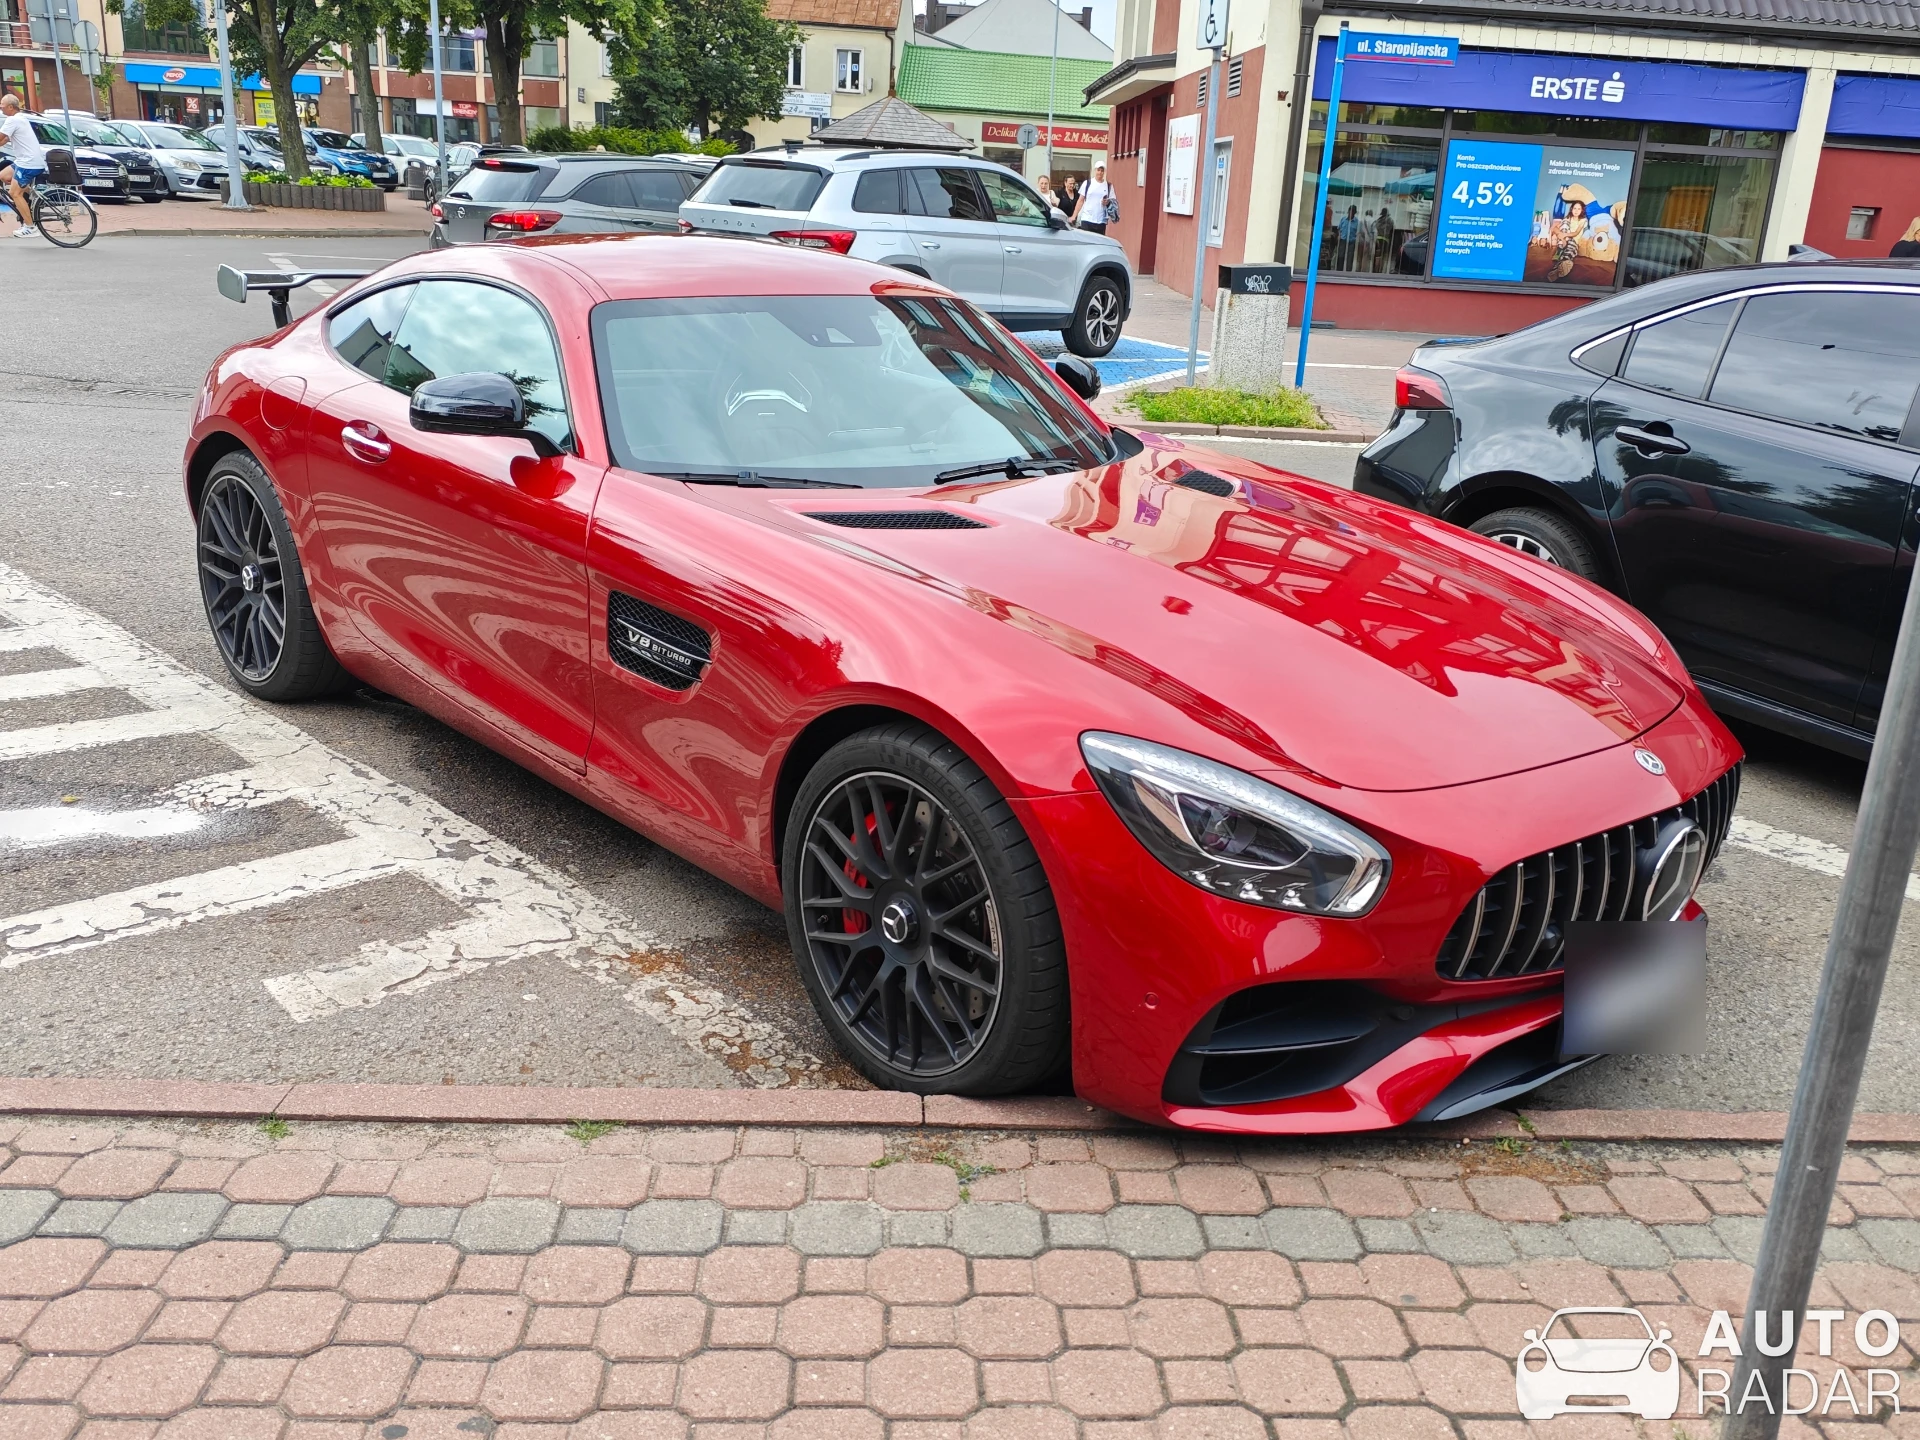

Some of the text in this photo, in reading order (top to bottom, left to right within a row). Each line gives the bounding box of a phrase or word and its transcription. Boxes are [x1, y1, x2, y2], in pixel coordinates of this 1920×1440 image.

[1357, 40, 1448, 57] ul. Staropijarska
[1530, 76, 1600, 100] ERSTE
[1548, 168, 1604, 178] zdrowie finansowe
[1581, 162, 1601, 171] budują
[1602, 163, 1621, 172] Twoje
[1451, 180, 1514, 208] 4,5%
[628, 630, 692, 666] V8 BITURBO
[924, 767, 994, 848] MICHELIN
